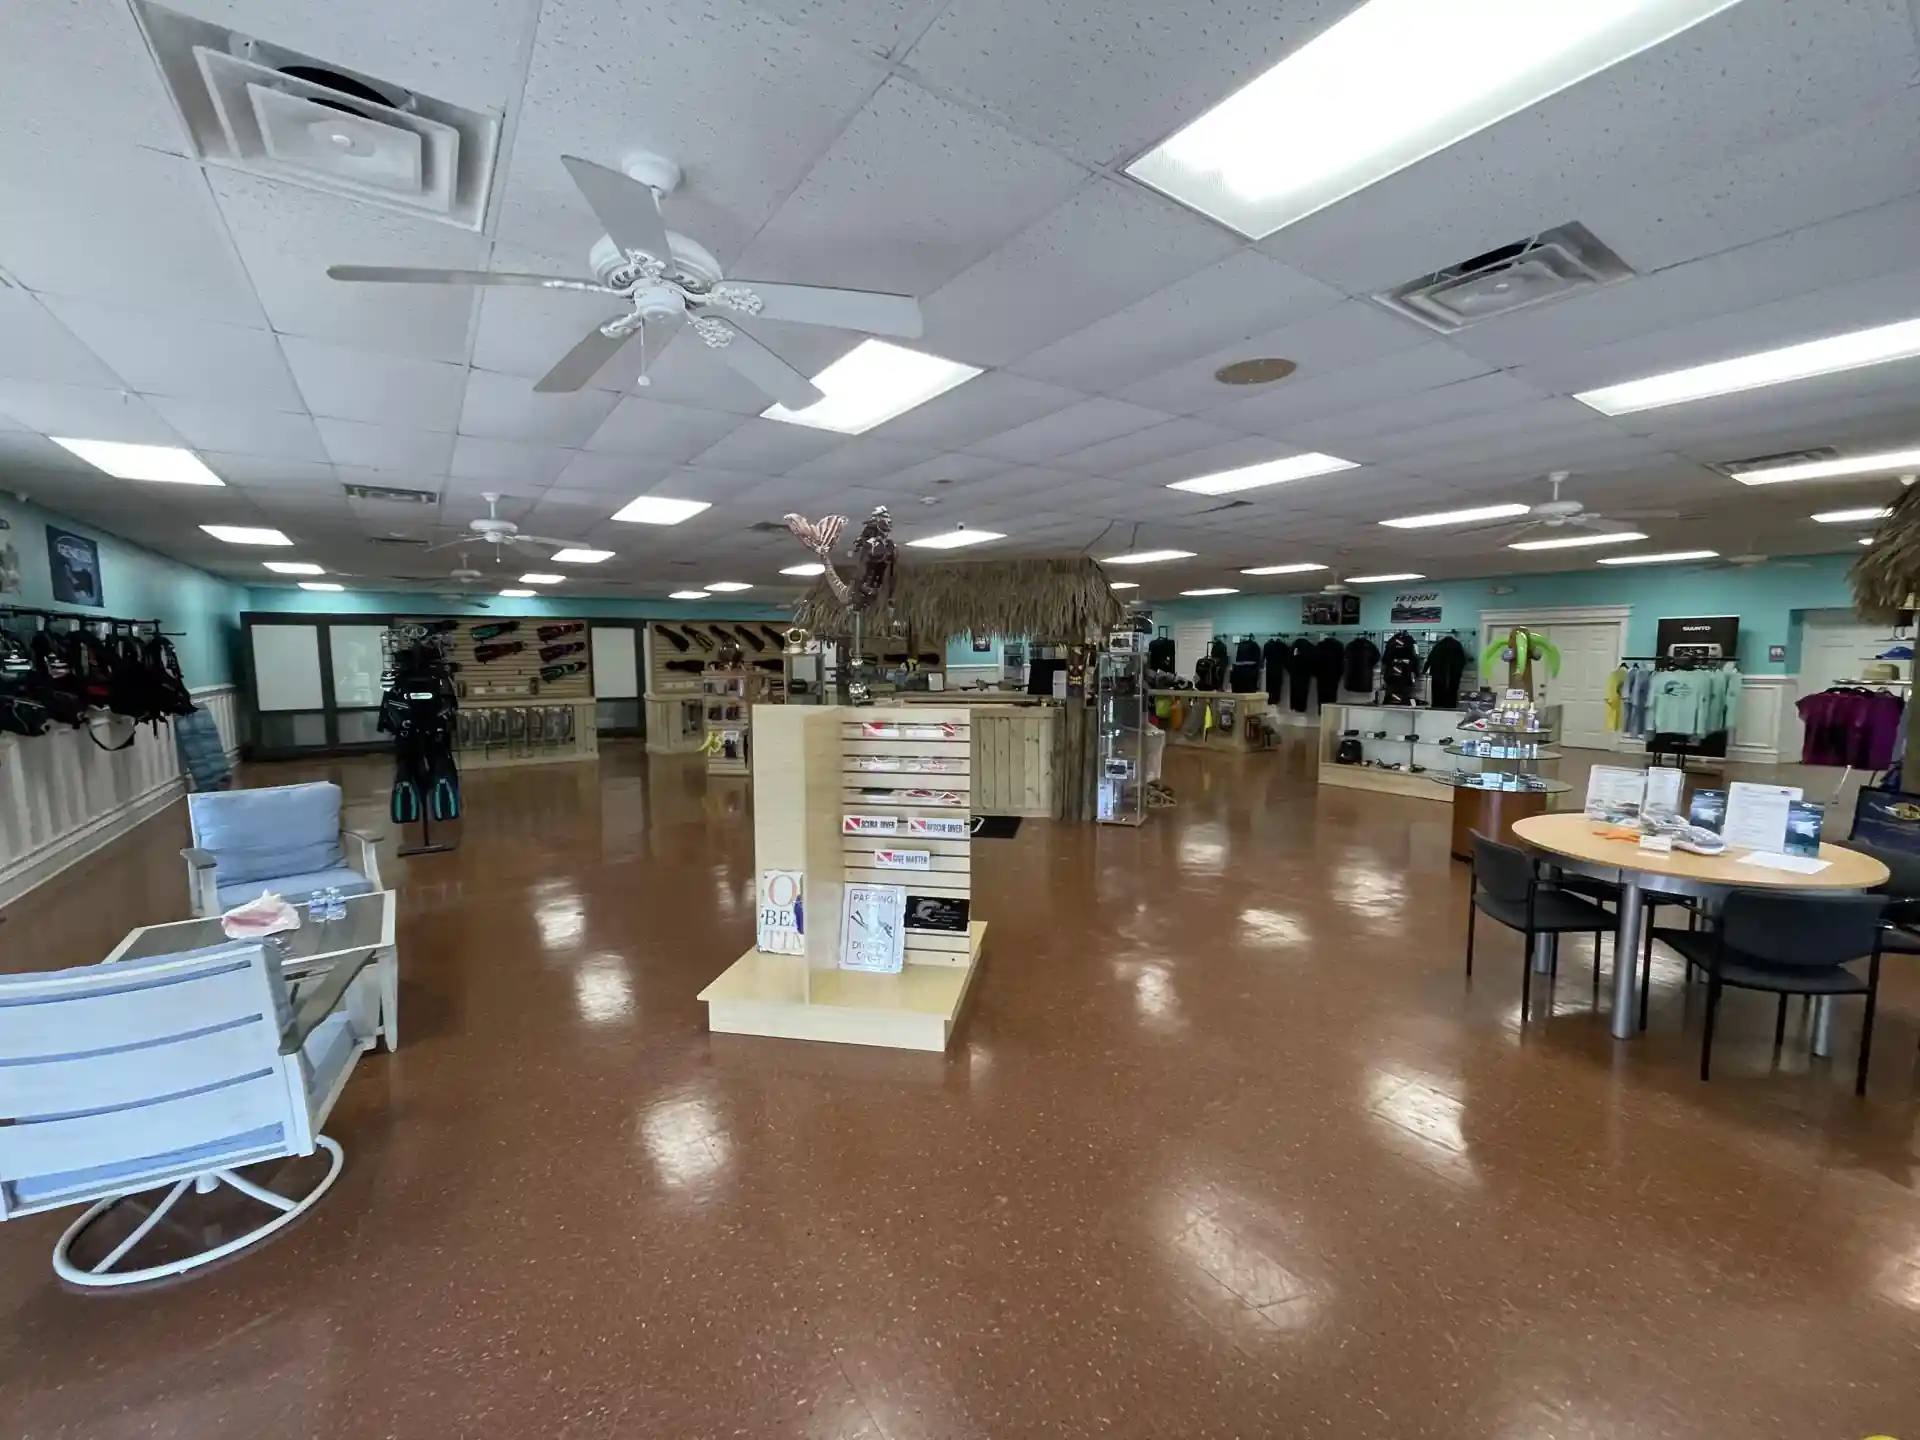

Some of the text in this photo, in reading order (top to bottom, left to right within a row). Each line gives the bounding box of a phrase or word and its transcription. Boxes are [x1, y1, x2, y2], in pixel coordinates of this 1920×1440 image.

[947, 823, 963, 833] DIVER
[853, 893, 893, 904] PARING
[764, 909, 797, 926] BE
